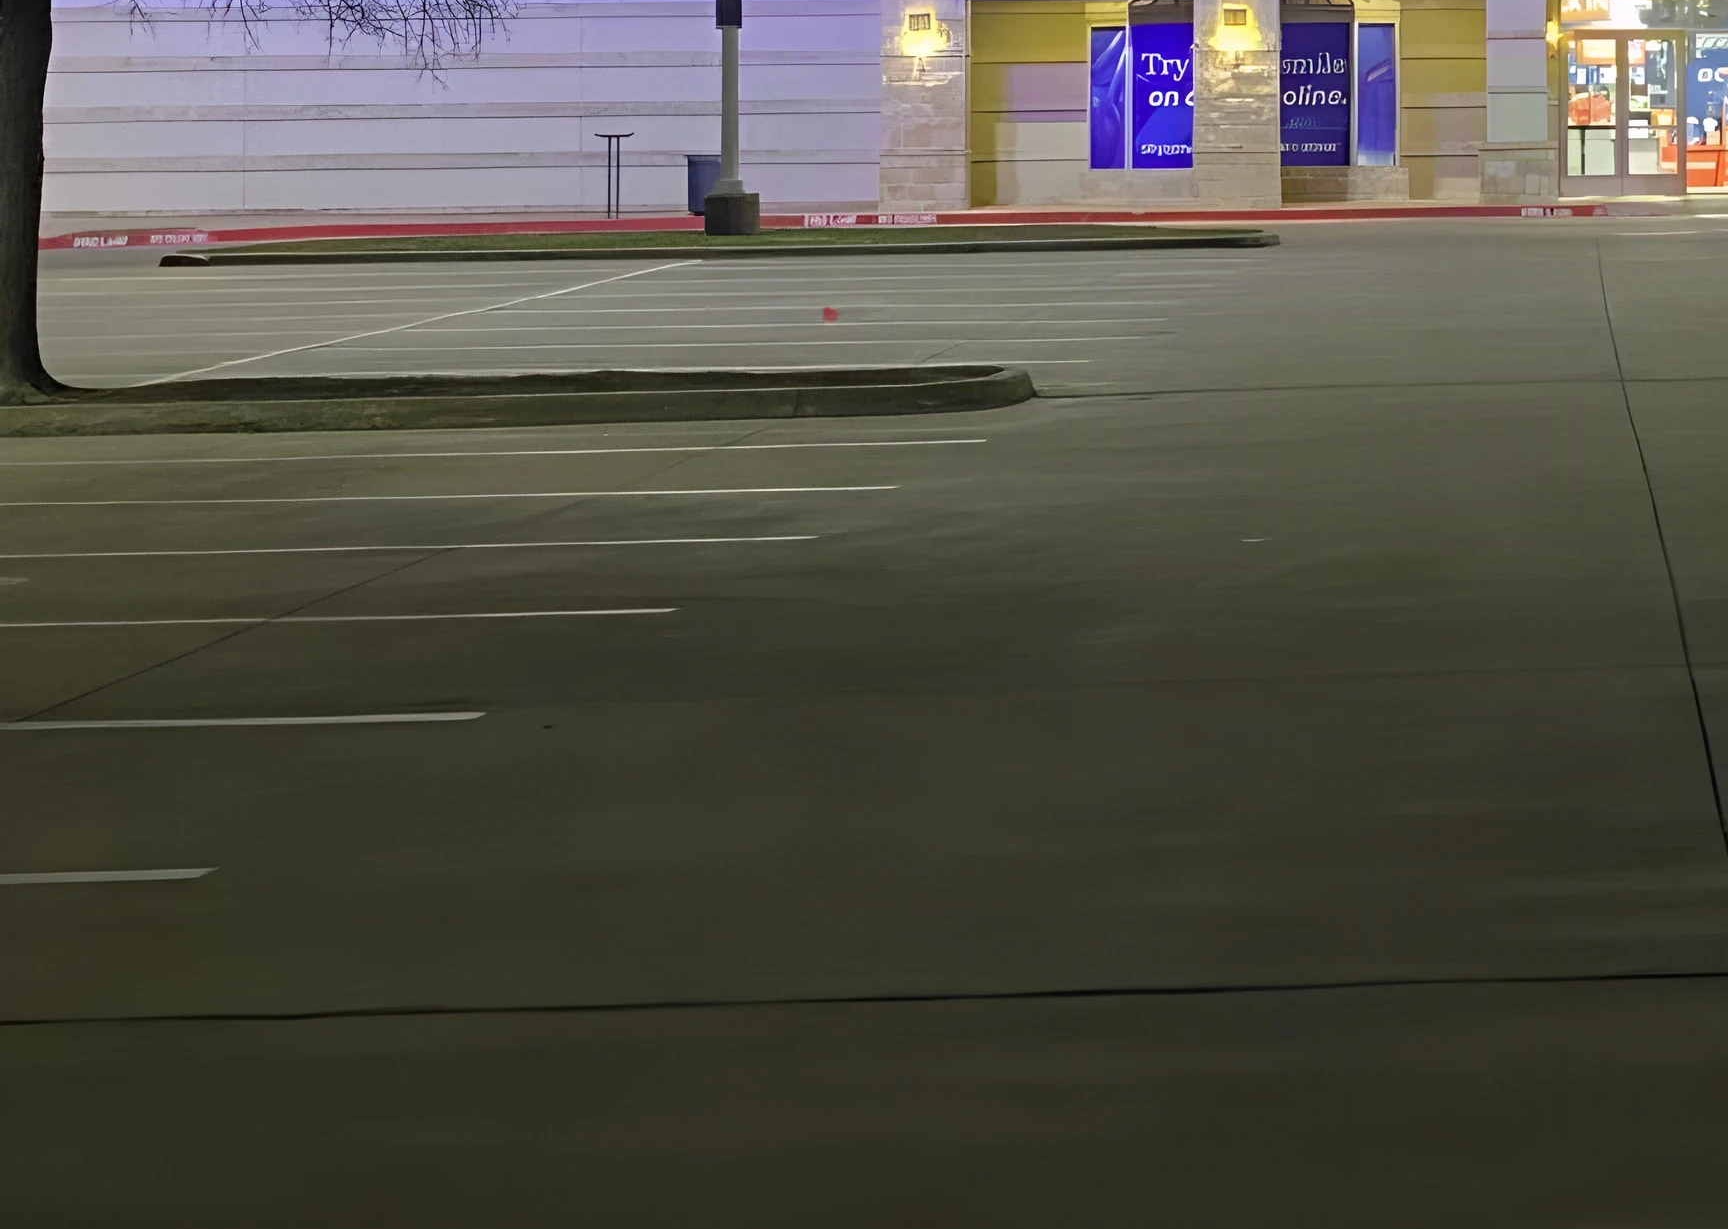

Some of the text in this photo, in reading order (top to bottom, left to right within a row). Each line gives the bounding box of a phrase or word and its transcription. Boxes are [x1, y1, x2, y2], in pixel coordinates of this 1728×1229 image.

[1141, 52, 1346, 82] Try smile
[1148, 90, 1179, 107] on
